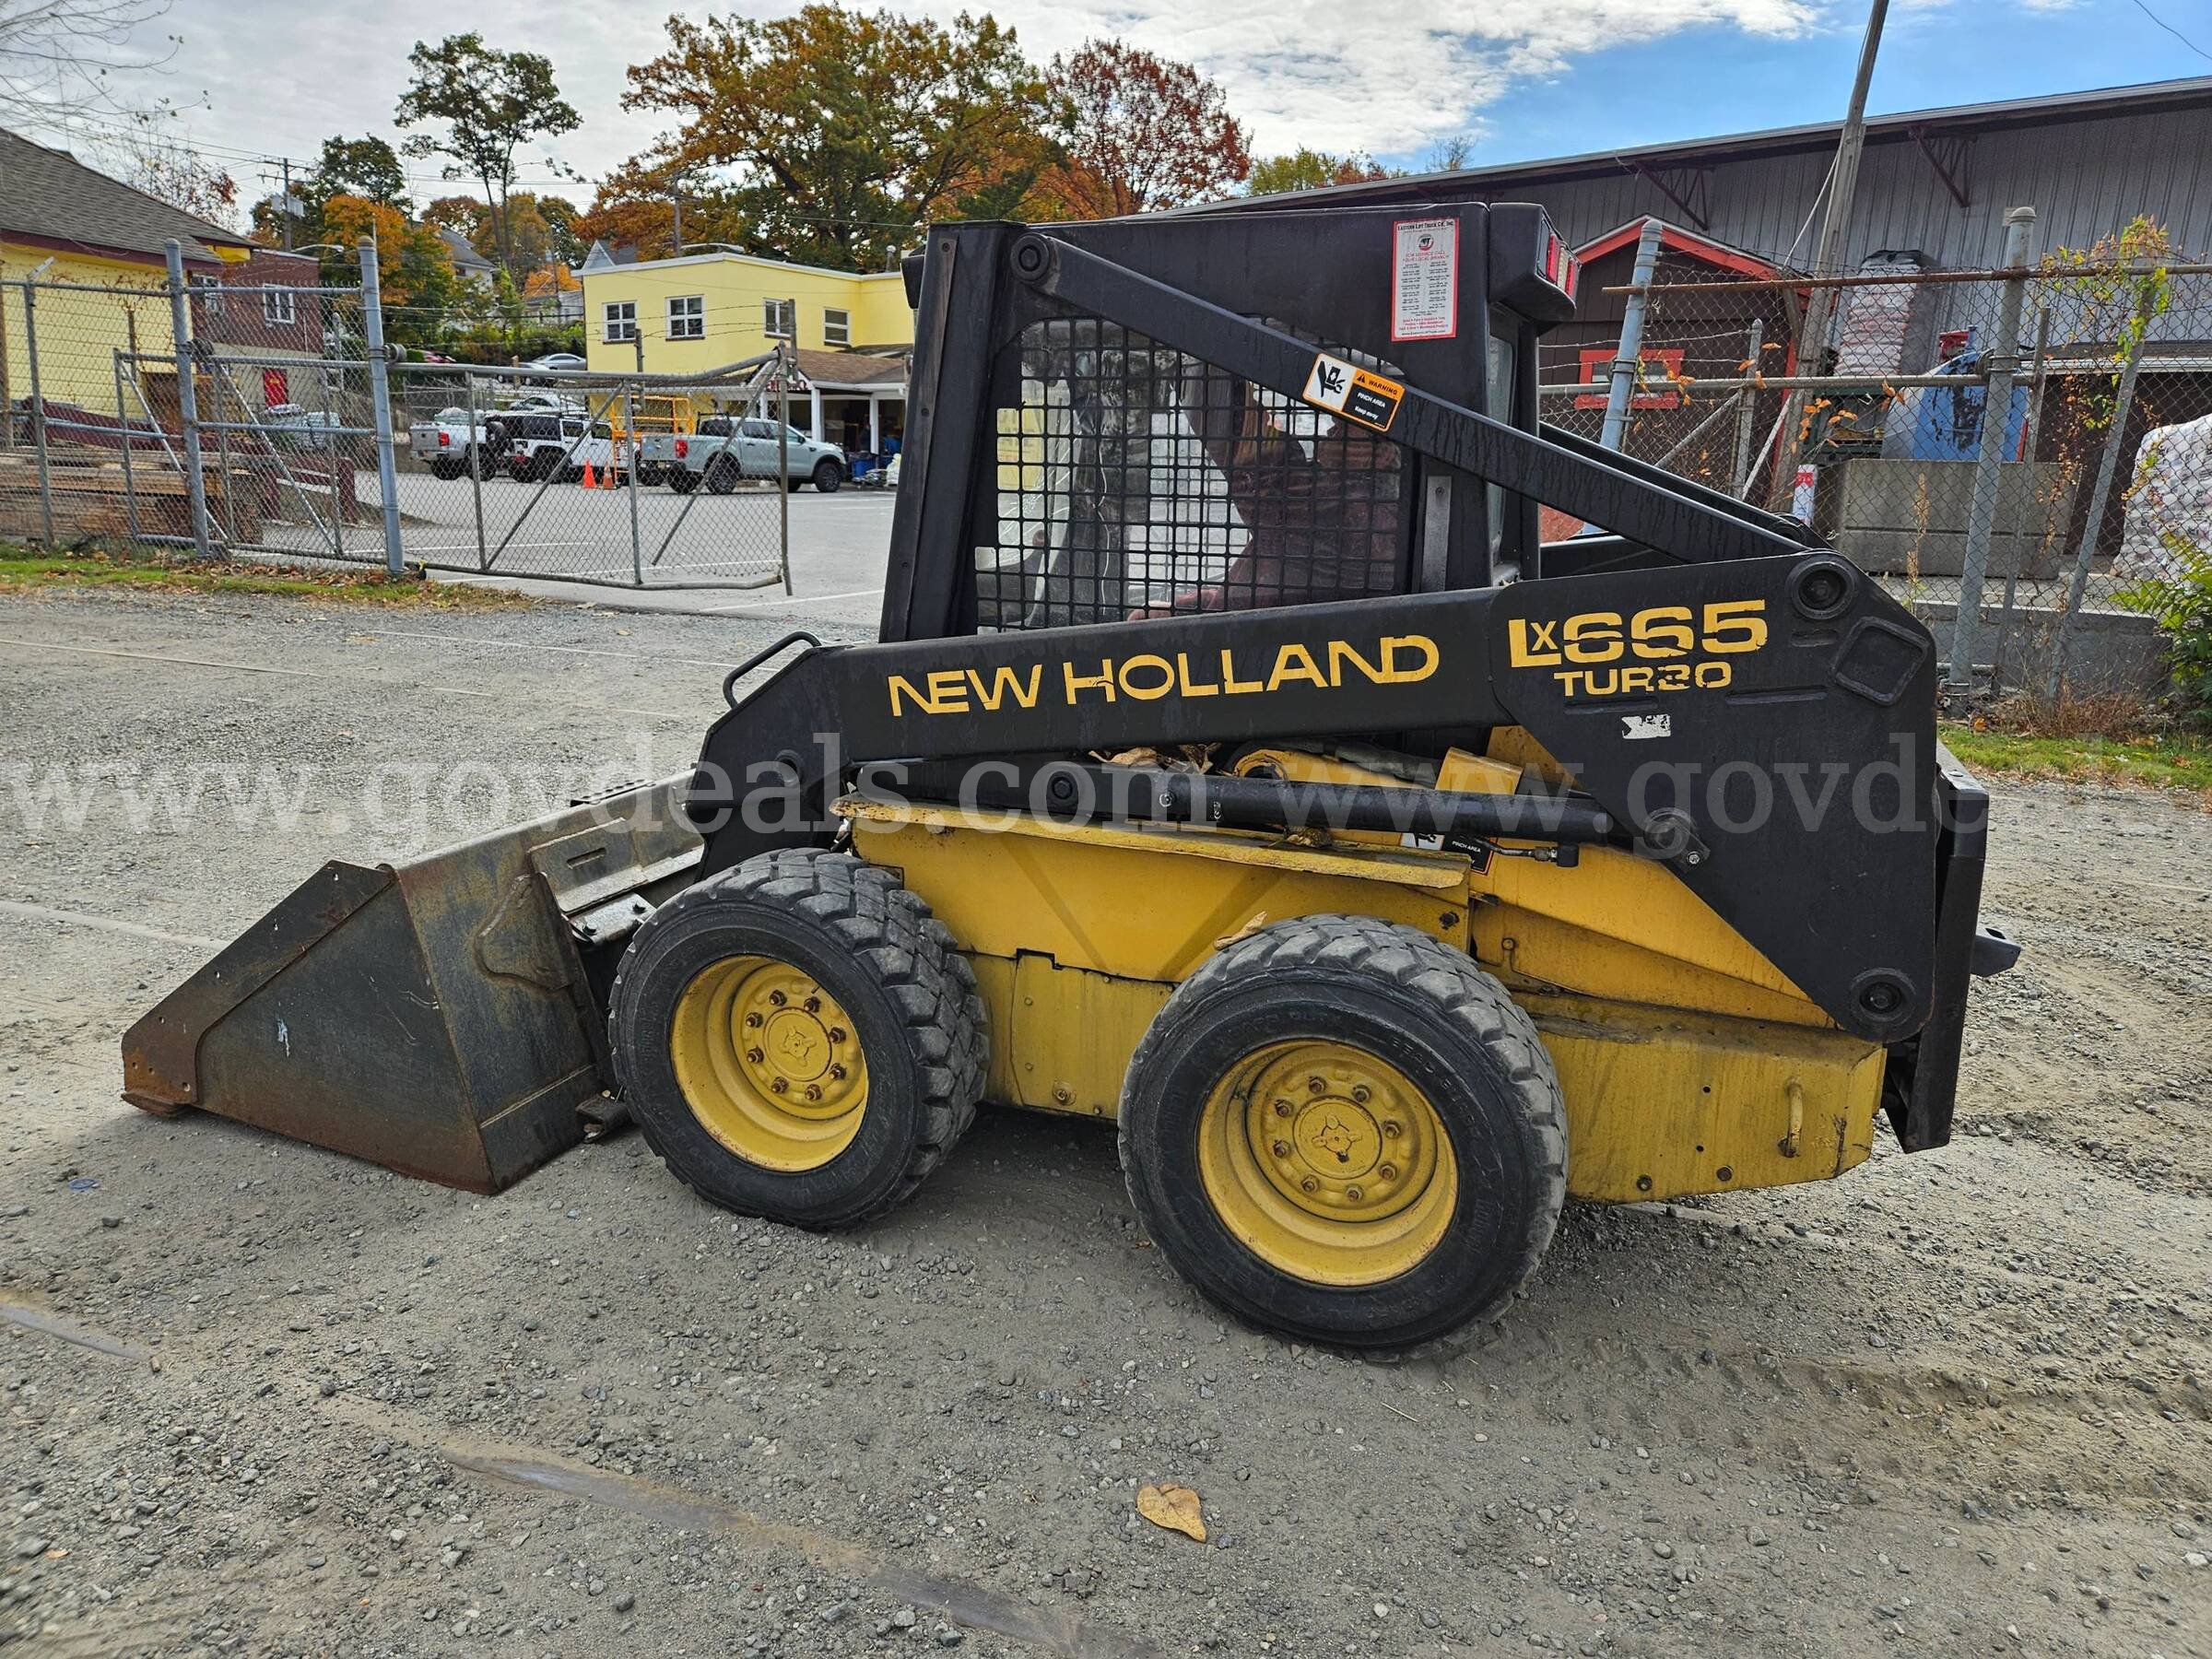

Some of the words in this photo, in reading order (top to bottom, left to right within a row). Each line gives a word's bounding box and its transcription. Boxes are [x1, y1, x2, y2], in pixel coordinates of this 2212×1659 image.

[1369, 379, 1398, 394] WARNING
[1357, 392, 1372, 402] PINCH
[1371, 397, 1386, 408] AREA
[888, 664, 1043, 717] NEW
[1063, 635, 1440, 705] HOLLAND
[1452, 841, 1467, 850] PINCH
[1467, 843, 1481, 853] AREA
